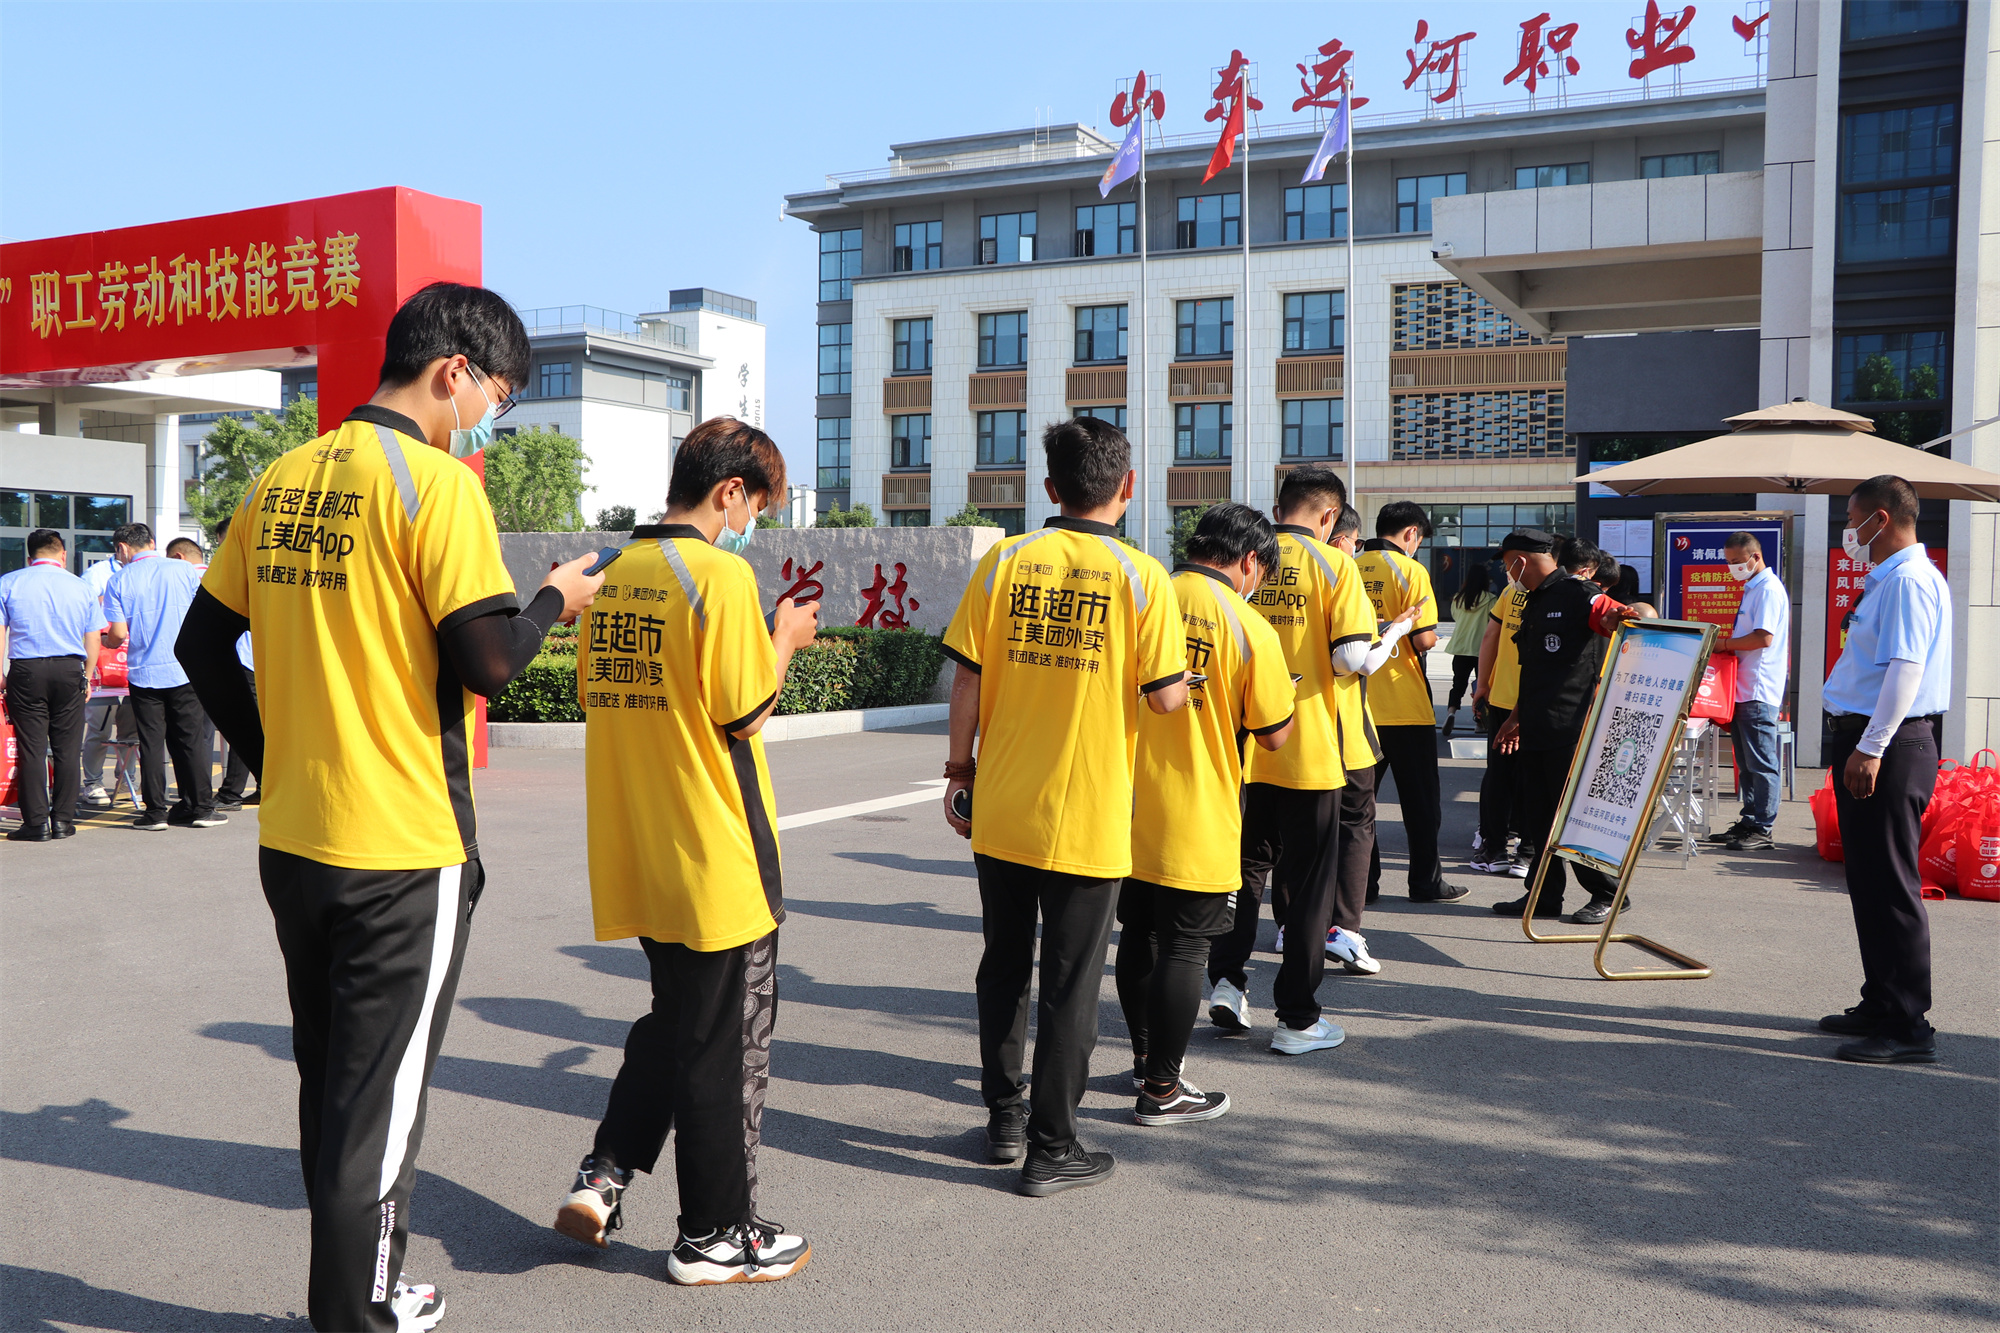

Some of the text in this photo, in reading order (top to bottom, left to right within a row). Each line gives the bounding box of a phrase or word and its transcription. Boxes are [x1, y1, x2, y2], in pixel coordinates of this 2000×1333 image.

[256, 520, 355, 563] 上美团App
[1032, 563, 1053, 575] 美团
[1071, 568, 1112, 582] 美团外卖
[1691, 572, 1742, 583] 疫情防控
[600, 585, 668, 603] 美团 美团外卖
[1835, 594, 1849, 607] 济
[1009, 583, 1111, 627] 逛超市
[589, 611, 666, 657] 逛超市
[1007, 620, 1105, 653] 上美团外卖
[1008, 649, 1100, 674] 美团配送 准时好用
[1614, 671, 1685, 692] 为了您和他人的健康
[624, 693, 668, 712] 准时好用
[1624, 690, 1663, 707] 请扫码登记
